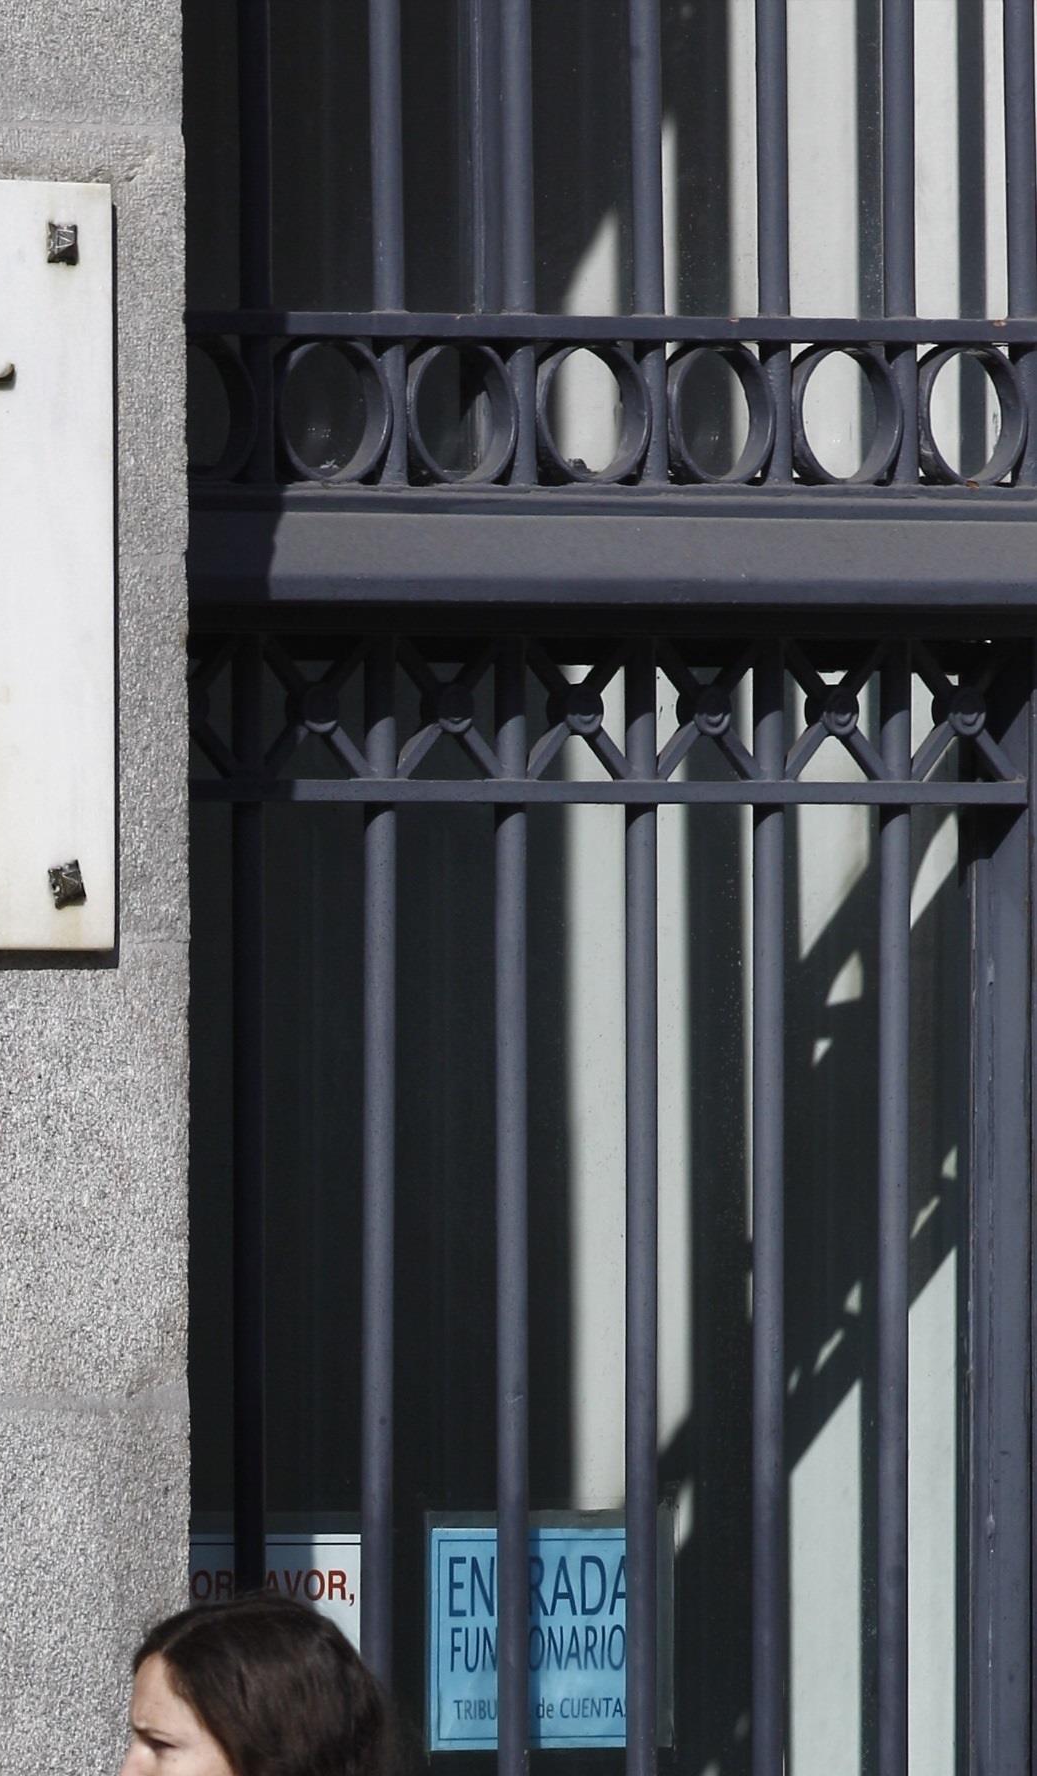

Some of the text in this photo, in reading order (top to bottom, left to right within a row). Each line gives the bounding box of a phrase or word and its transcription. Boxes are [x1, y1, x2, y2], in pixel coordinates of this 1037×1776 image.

[191, 1569, 355, 1607] OR AVOR,
[449, 1555, 626, 1617] ENRADA
[536, 1697, 555, 1719] de
[560, 1696, 626, 1719] CUENTA
